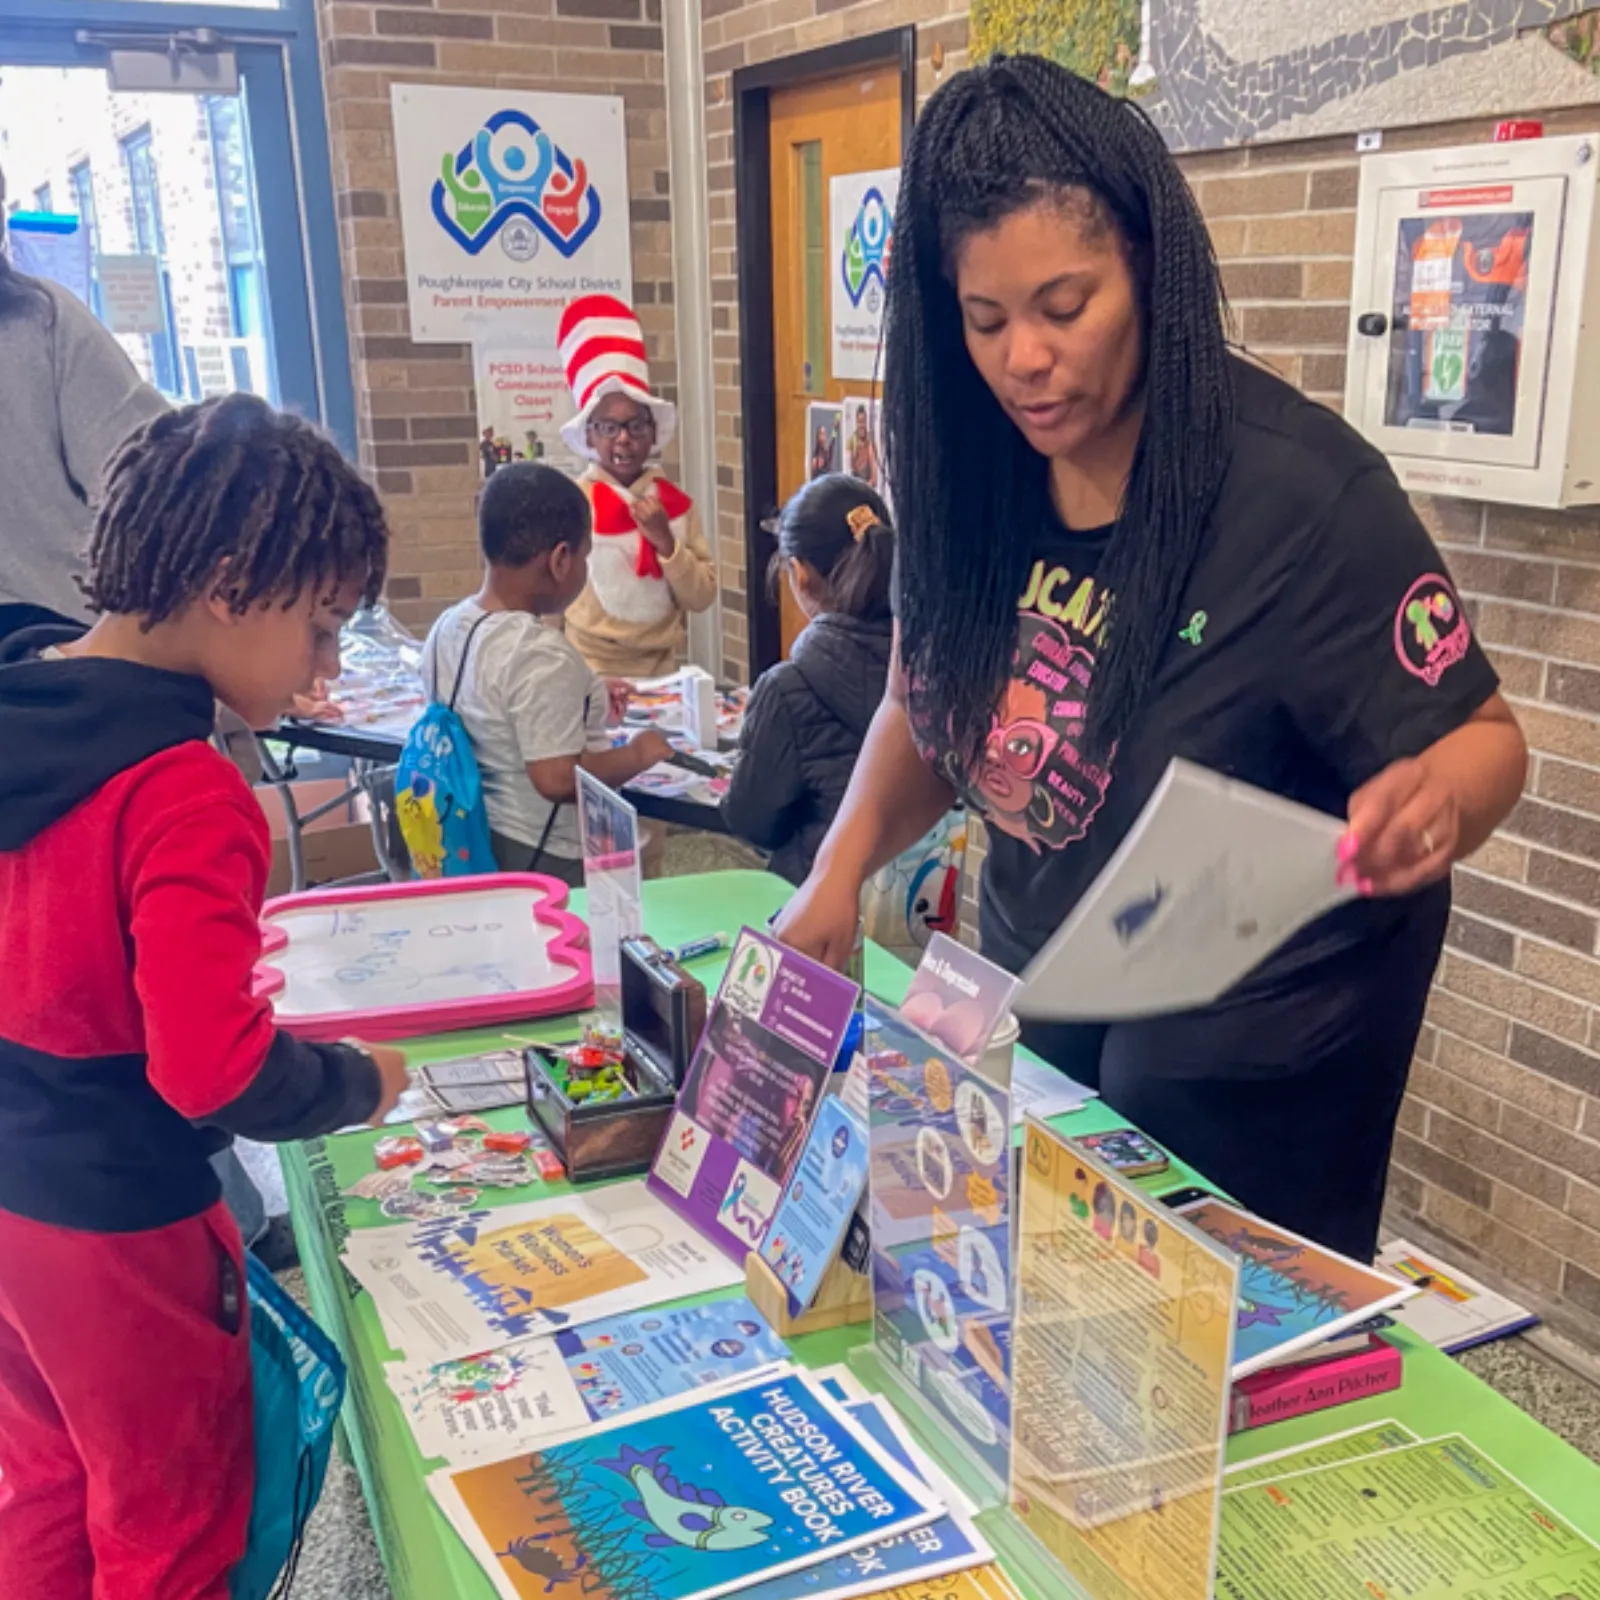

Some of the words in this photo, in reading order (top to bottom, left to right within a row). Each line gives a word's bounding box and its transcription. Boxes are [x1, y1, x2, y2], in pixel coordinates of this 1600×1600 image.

[418, 275, 504, 292] Poughkeepsie
[508, 276, 532, 292] City
[536, 276, 576, 289] School
[580, 276, 621, 290] District
[433, 295, 472, 307] Parent
[477, 296, 566, 310] Empowerment
[1304, 1386, 1335, 1402] Ann
[751, 1412, 856, 1516] CREATURES
[761, 1387, 843, 1463] HUDSON
[829, 1461, 895, 1519] RIVER
[708, 1407, 795, 1485] ACTIVITY
[780, 1486, 844, 1544] BOOK
[851, 1546, 887, 1576] OK
